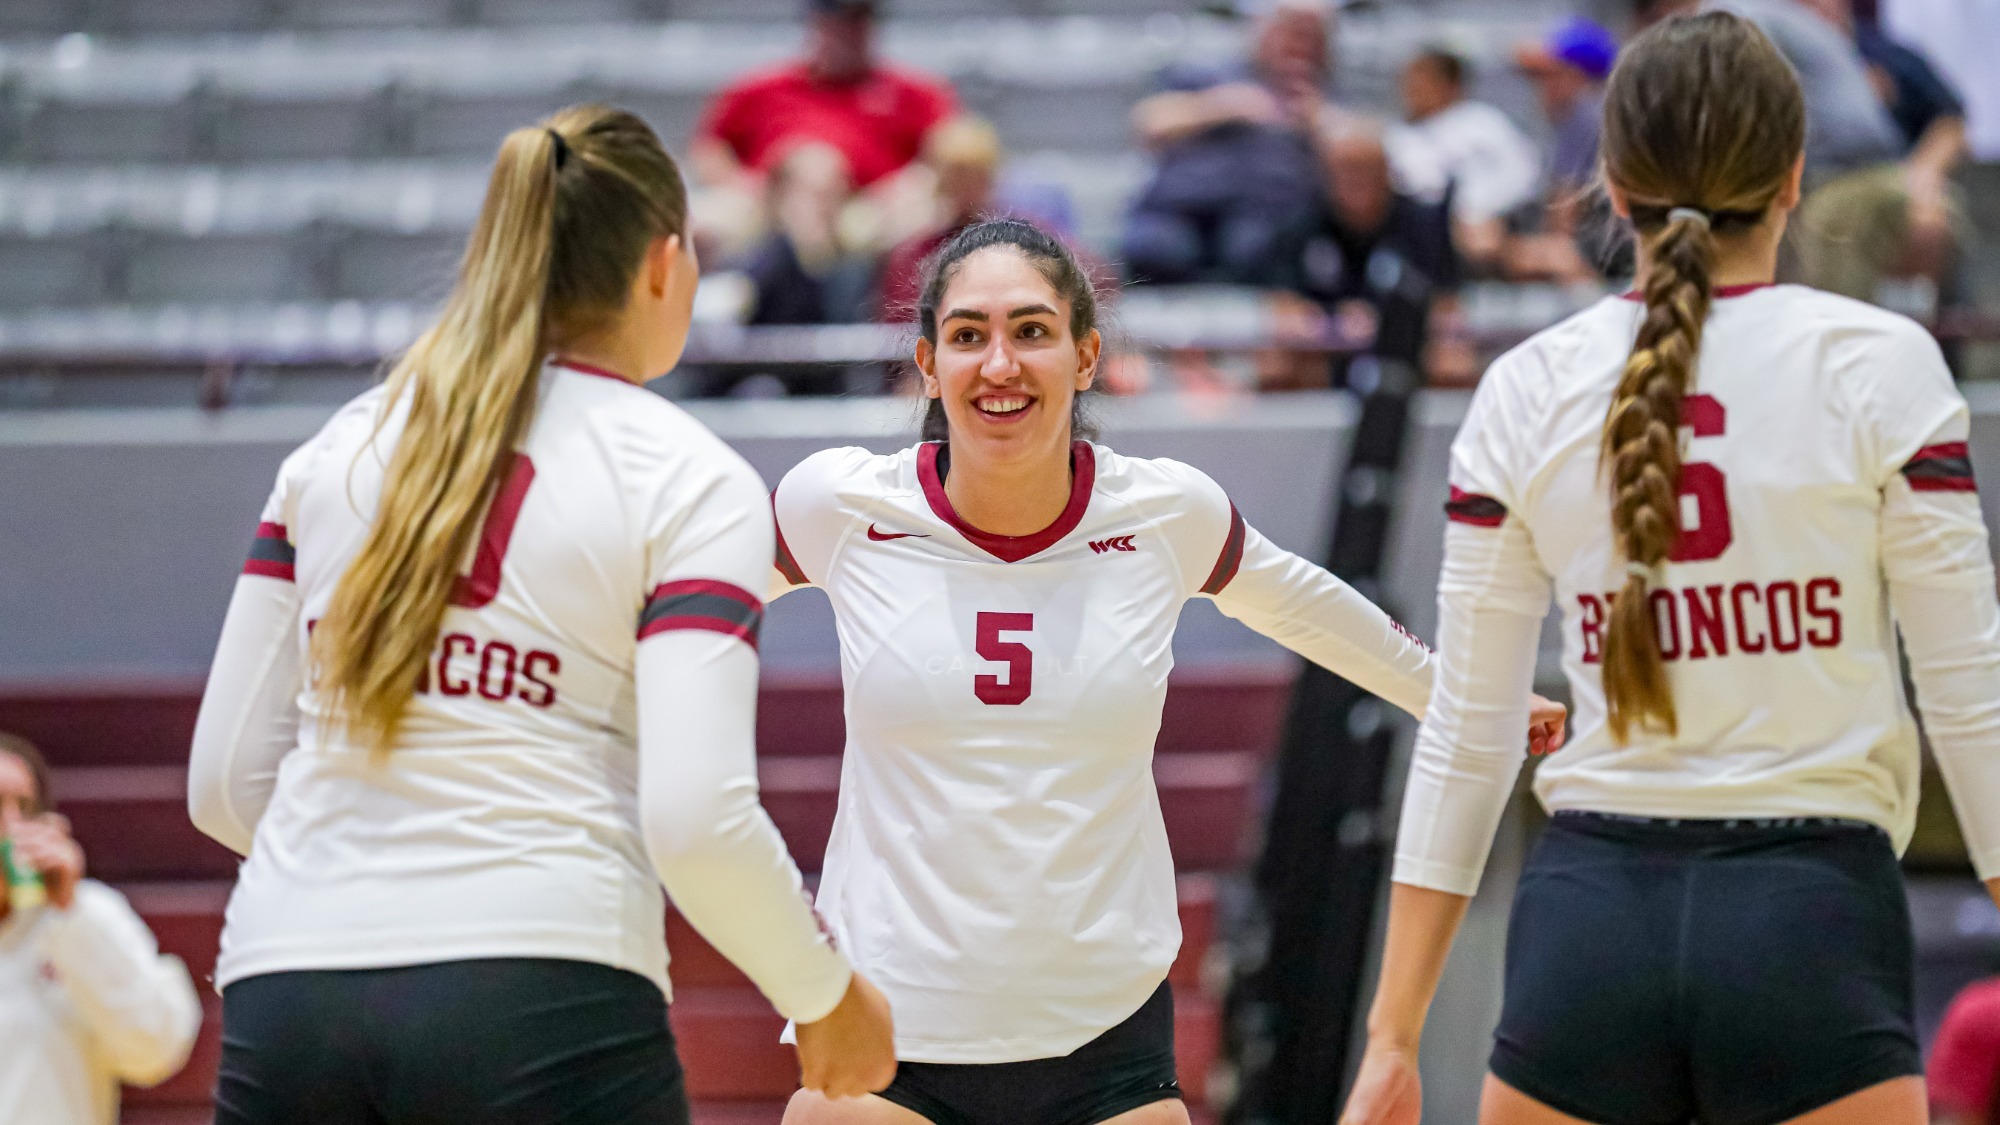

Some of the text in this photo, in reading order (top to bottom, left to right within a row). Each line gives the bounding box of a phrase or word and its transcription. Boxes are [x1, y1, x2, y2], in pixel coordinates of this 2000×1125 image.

[1668, 394, 1735, 564] 6
[1088, 534, 1137, 555] WCC
[974, 611, 1034, 705] 5
[1577, 577, 1842, 663] BONCOS
